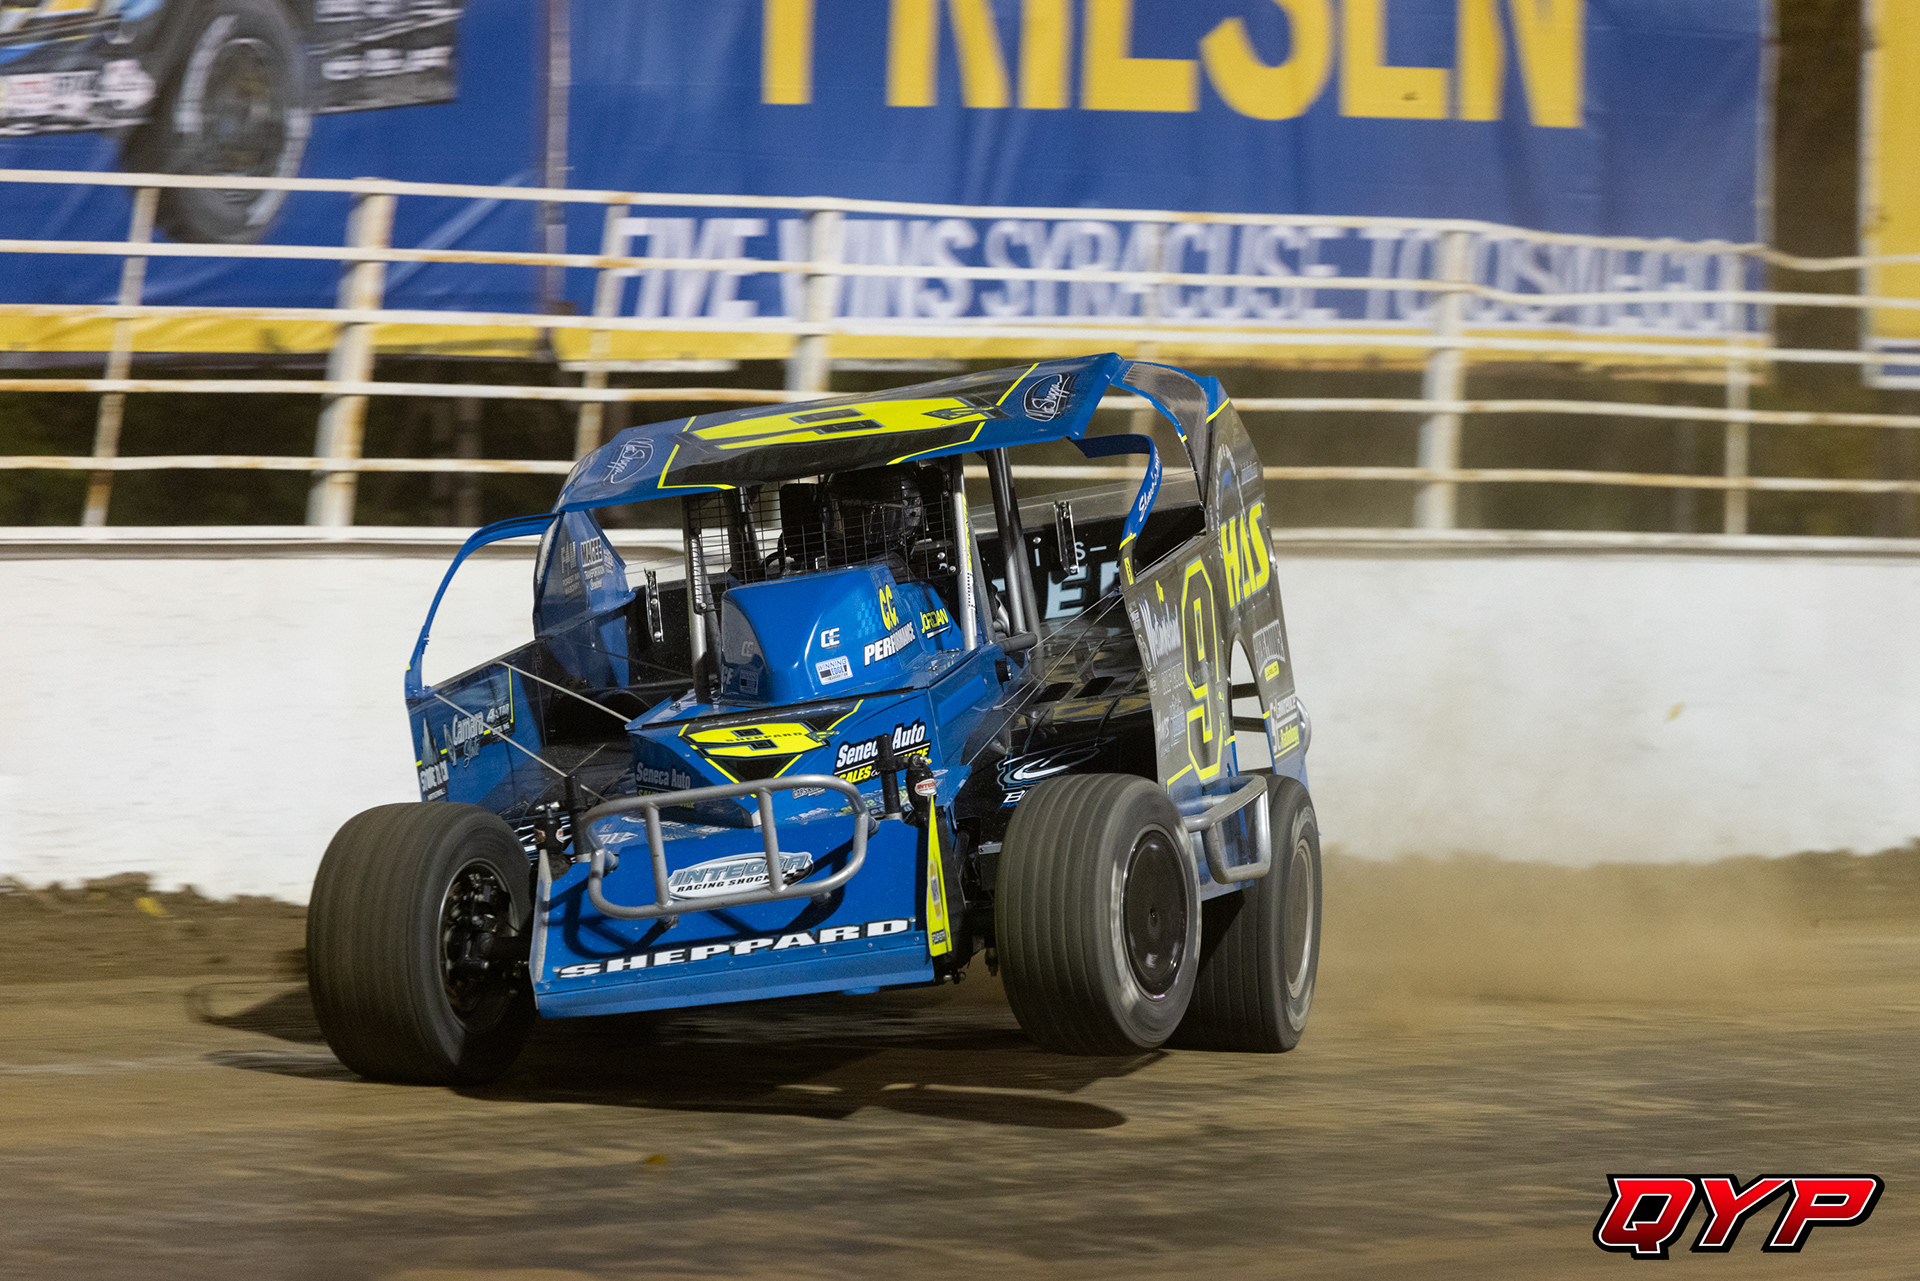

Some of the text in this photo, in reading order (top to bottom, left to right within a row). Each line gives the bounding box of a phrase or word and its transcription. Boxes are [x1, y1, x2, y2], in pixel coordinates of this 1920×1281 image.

[980, 220, 1344, 321] SYRACUSE
[919, 607, 949, 634] JORDAN
[817, 658, 847, 671] WINNING
[1182, 559, 1224, 782] 9
[725, 732, 803, 743] SHEPPARD
[836, 740, 879, 768] Senec
[892, 722, 926, 750] Auto
[636, 762, 691, 790] Seneca Auto
[676, 874, 775, 893] RACING SHOCK
[560, 919, 909, 979] SHEPPARD
